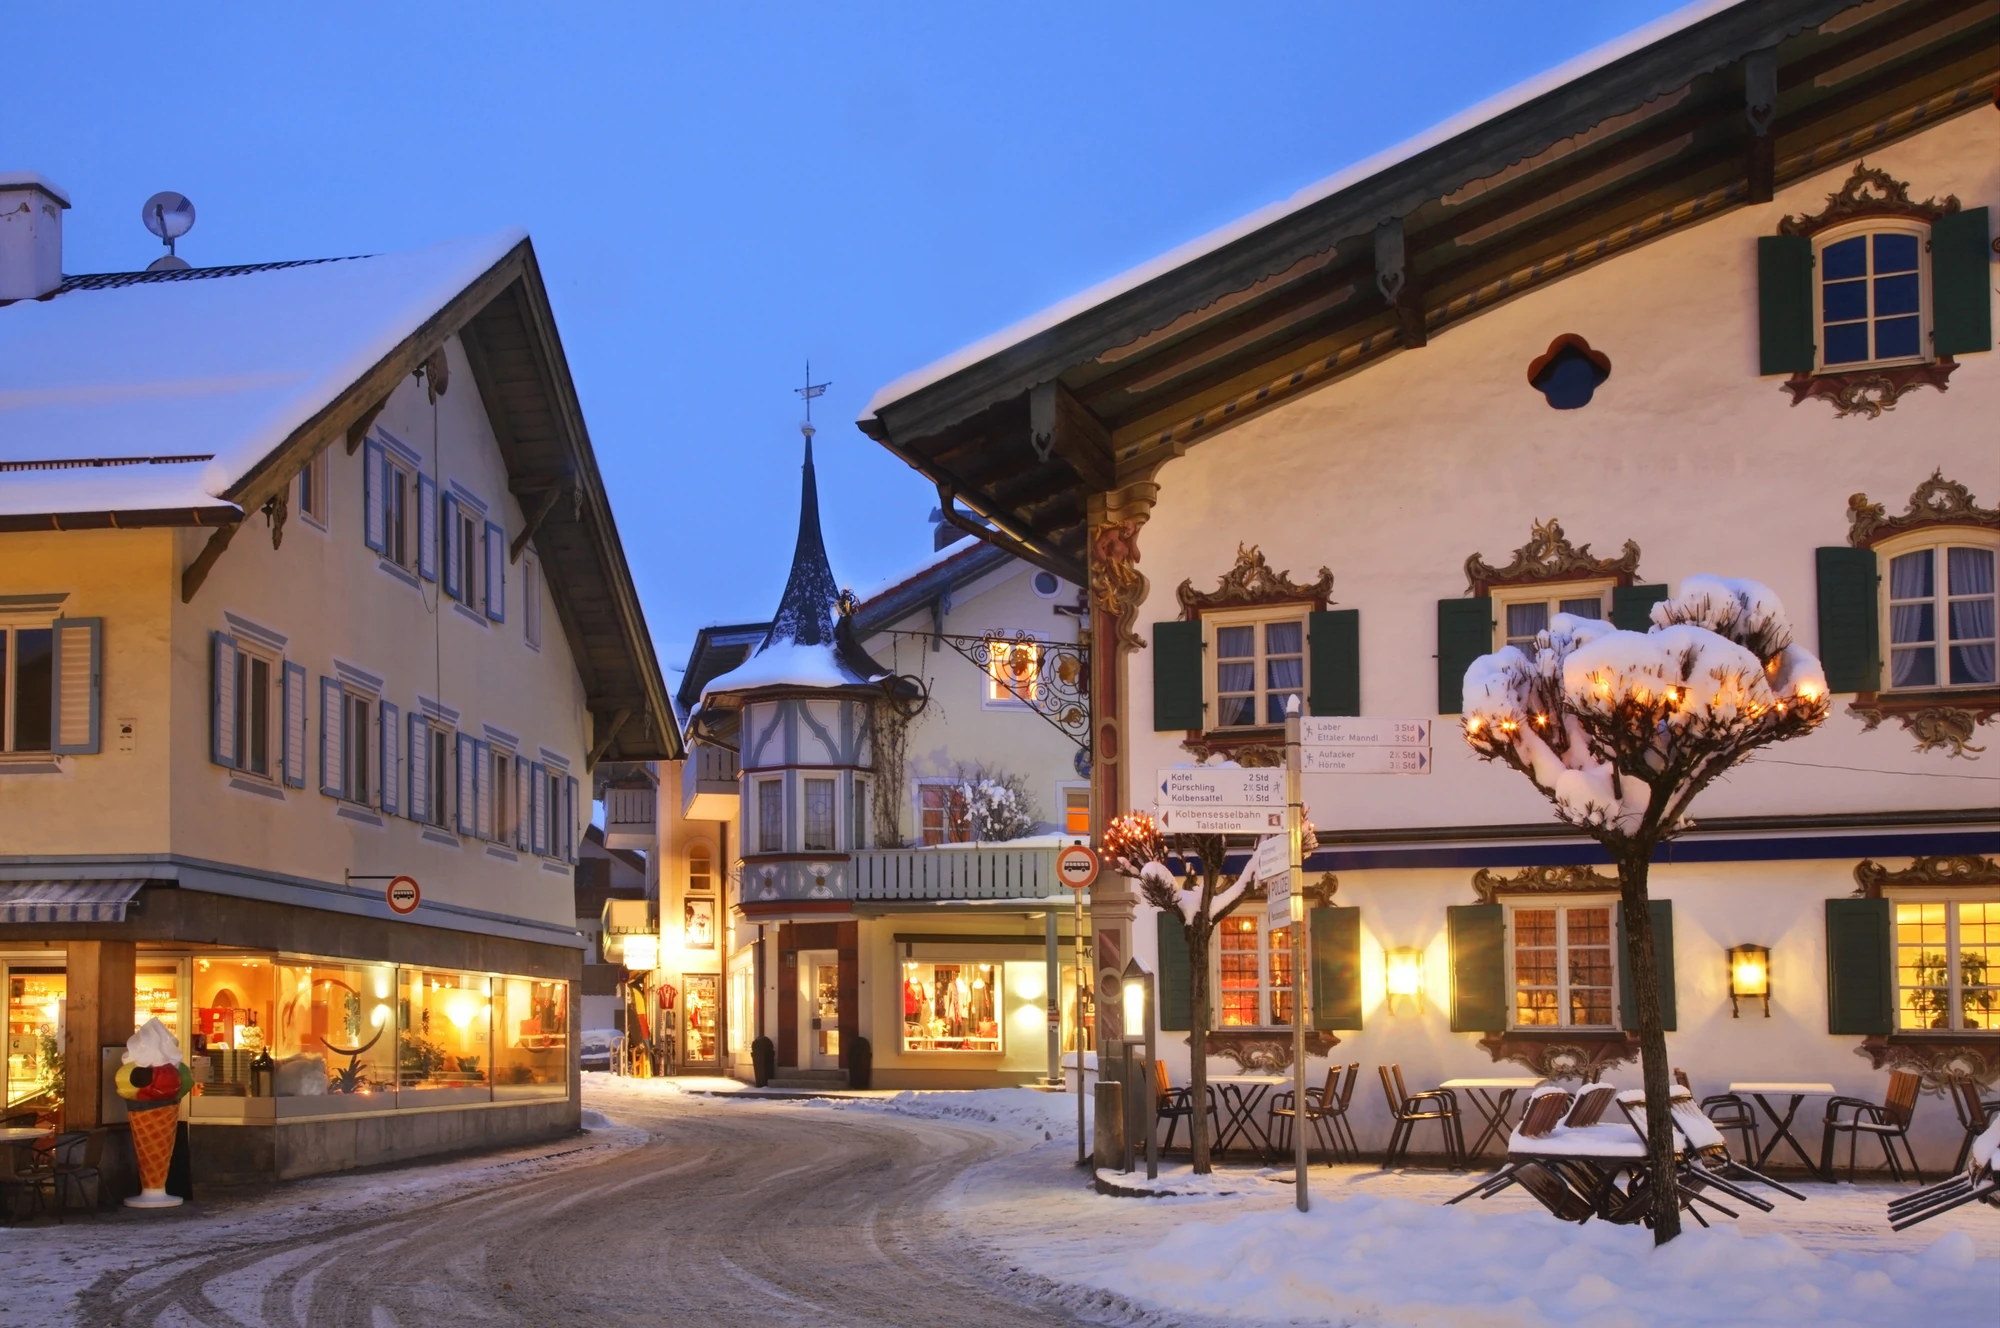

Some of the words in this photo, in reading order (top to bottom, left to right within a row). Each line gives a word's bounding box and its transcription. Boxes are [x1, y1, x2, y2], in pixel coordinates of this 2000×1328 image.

[1317, 723, 1342, 731] Laber
[1394, 724, 1400, 732] 3
[1401, 724, 1415, 732] Std
[1317, 733, 1345, 741] Ettaler
[1349, 734, 1379, 742] Manndl
[1318, 750, 1356, 758] Aufacker
[1402, 751, 1416, 759] Std
[1318, 761, 1346, 769] Hörnle
[1171, 773, 1193, 781] Kofel
[1171, 783, 1215, 792] Pürschling
[1171, 794, 1223, 802] Kolbensattel
[1256, 794, 1269, 802] Std
[1175, 810, 1261, 818] Kolbensesselbahn
[1196, 821, 1241, 829] Talstation
